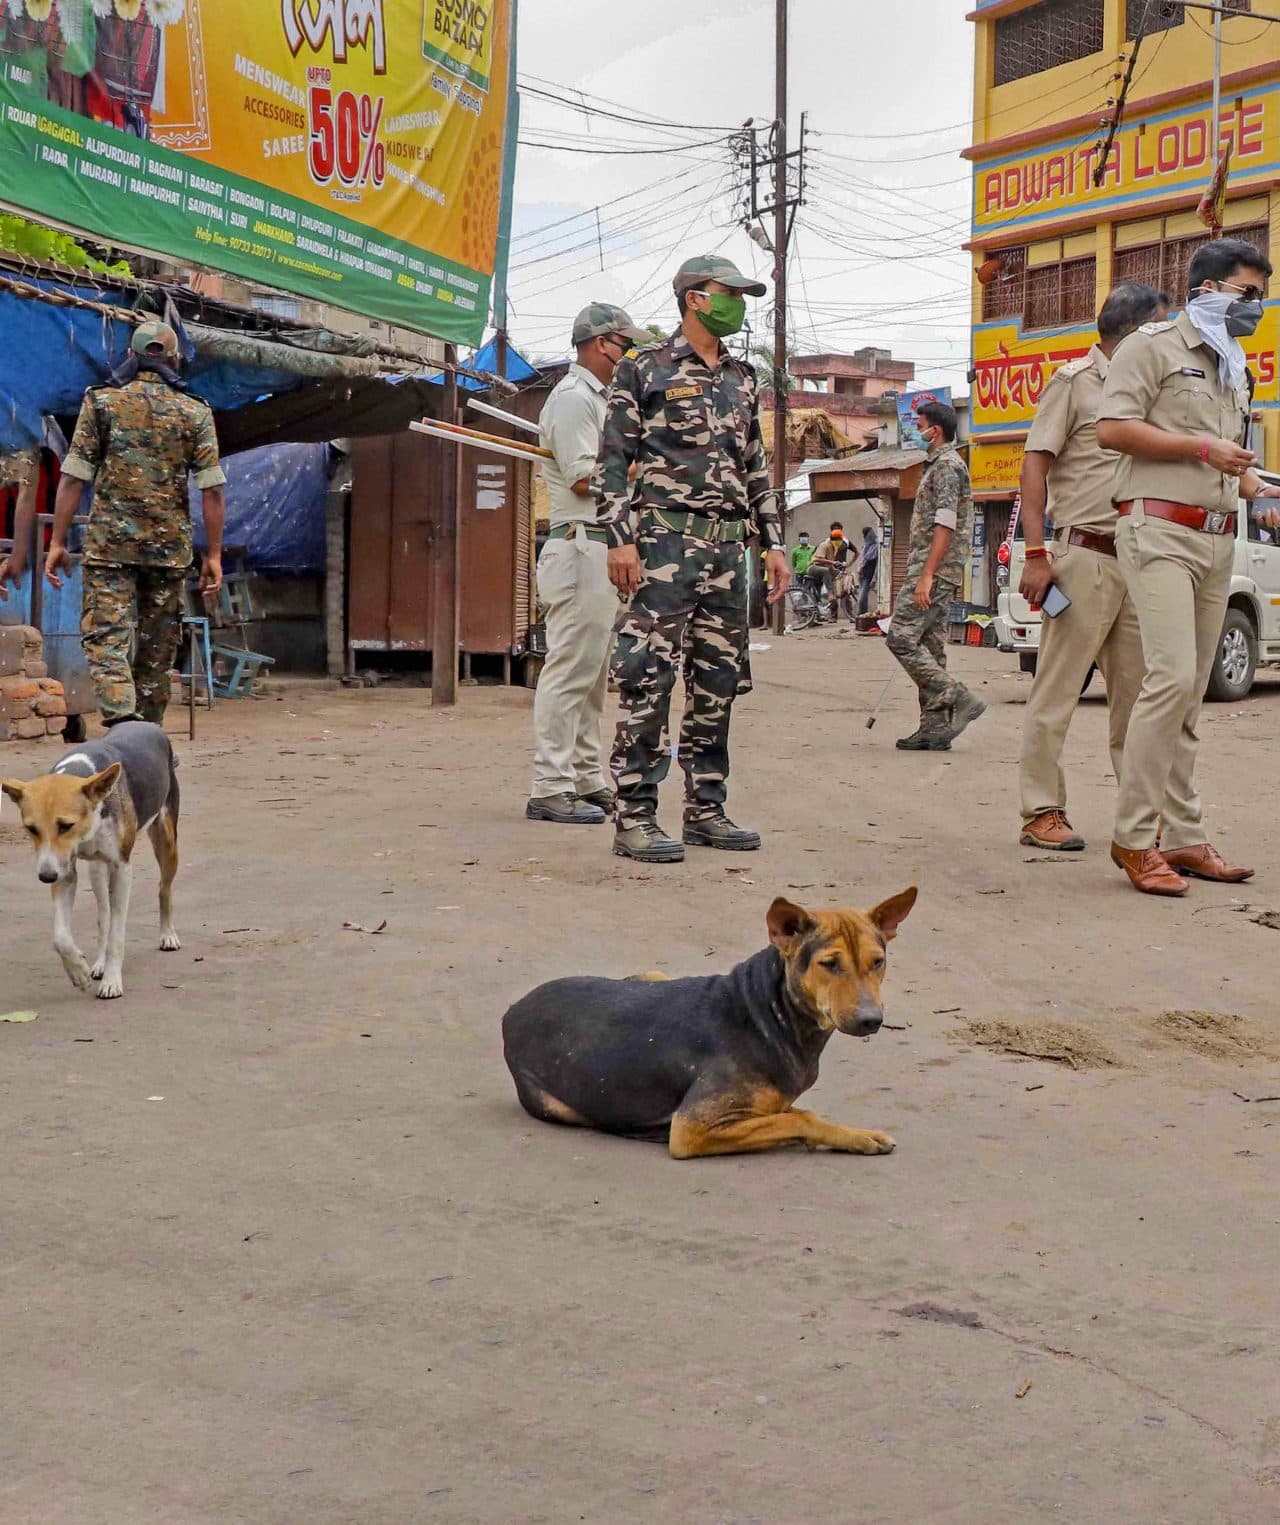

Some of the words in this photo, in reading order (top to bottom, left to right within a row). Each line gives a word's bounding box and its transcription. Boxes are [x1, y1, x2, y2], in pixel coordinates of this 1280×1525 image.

[234, 54, 306, 108] MENSWEAR
[307, 66, 332, 82] UPTO
[243, 96, 305, 129] ACCESSORIES
[308, 86, 386, 188] 50%
[262, 134, 305, 159] SAREE
[984, 139, 1122, 214] ADWAITA
[1134, 103, 1265, 182] LODGE
[80, 160, 122, 188] MURARAI
[130, 178, 181, 207] RAMPURHAT
[188, 197, 224, 222] SAINTHIA
[230, 212, 248, 229] SURI
[86, 137, 141, 169] ALIPURDUAR
[148, 160, 183, 184] BAGNAN
[189, 174, 225, 198] BARASAT
[230, 189, 265, 213] BONGAON
[270, 204, 296, 224] BOLPUR
